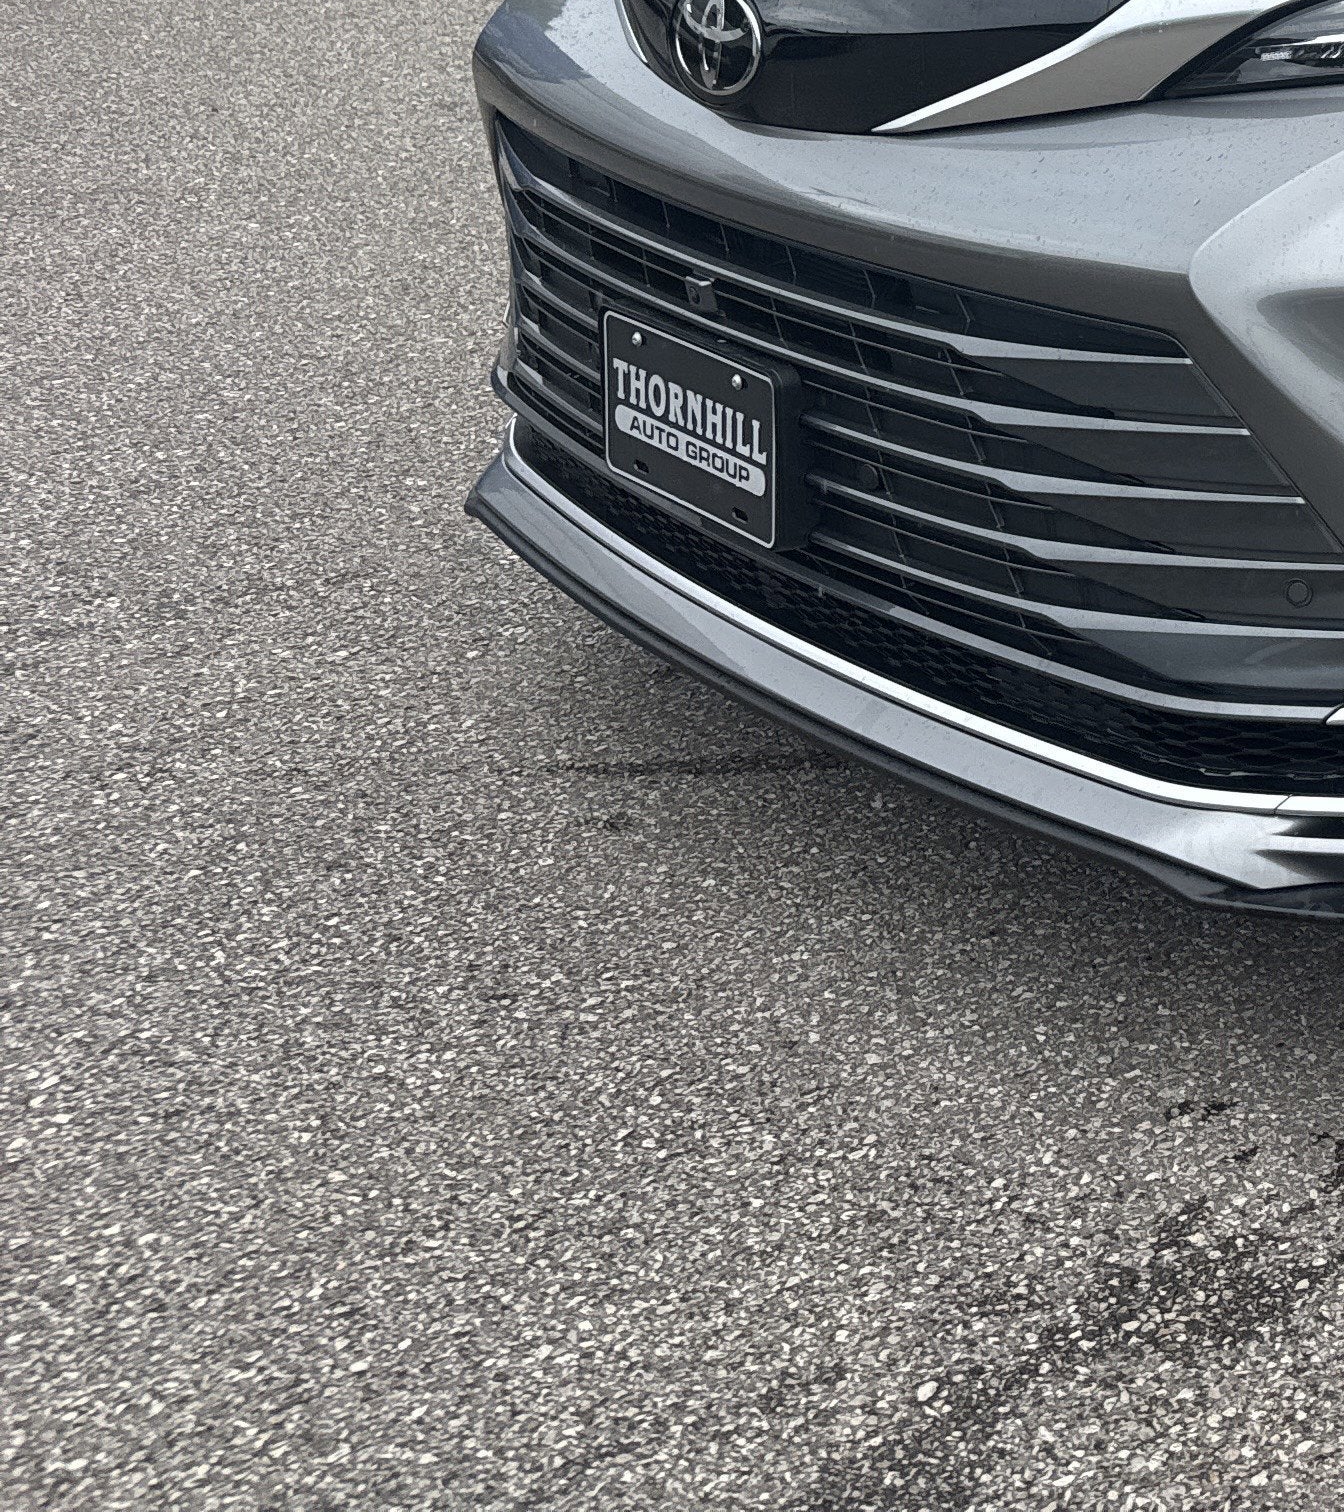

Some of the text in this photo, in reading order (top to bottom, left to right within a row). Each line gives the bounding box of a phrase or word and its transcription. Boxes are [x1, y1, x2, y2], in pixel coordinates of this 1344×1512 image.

[612, 357, 767, 466] THORNHILL
[629, 415, 750, 484] AUTO GROUP
